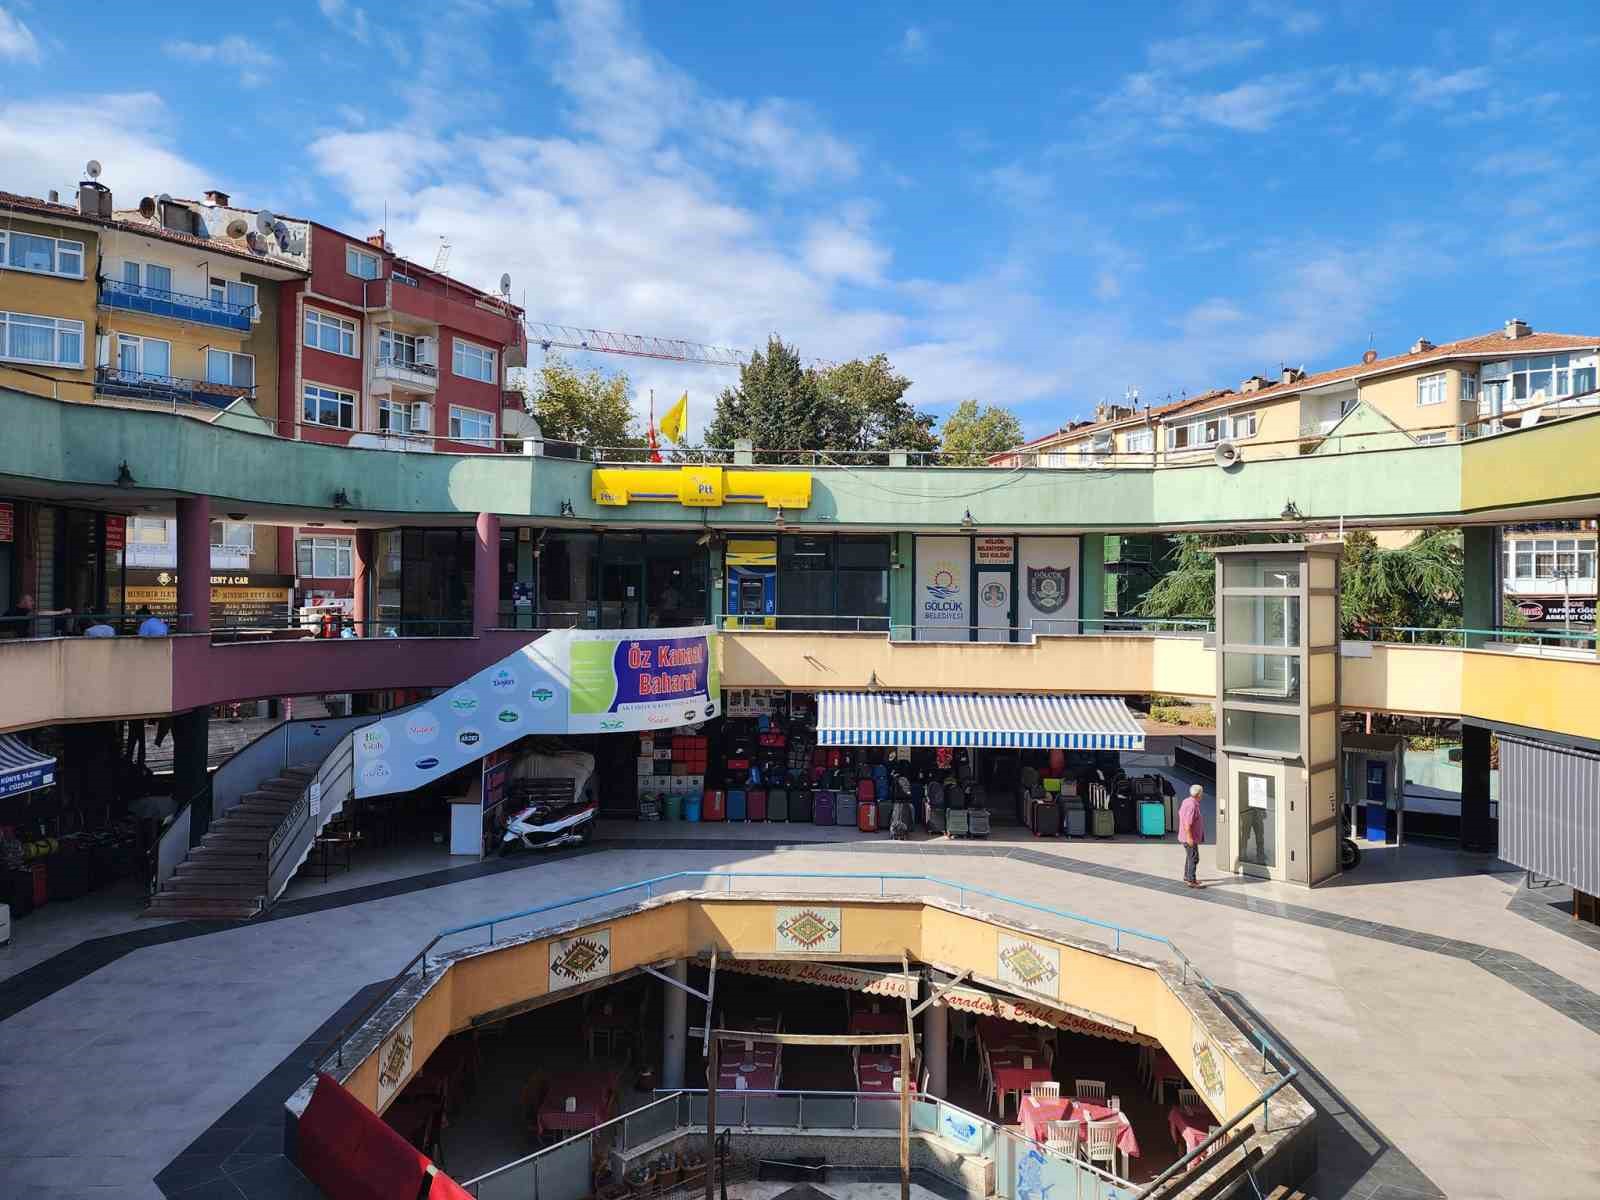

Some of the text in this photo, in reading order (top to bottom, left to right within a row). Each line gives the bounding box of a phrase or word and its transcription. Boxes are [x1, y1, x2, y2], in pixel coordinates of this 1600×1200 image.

[698, 483, 713, 495] Ptt
[228, 576, 234, 584] A
[234, 576, 249, 584] CAR
[925, 599, 962, 611] GÖLCÜK
[925, 611, 963, 621] BELEDİYESİ
[628, 642, 705, 669] Öz Kanaat
[639, 670, 697, 696] Baharat
[799, 965, 859, 986] Lokantası
[1013, 1001, 1054, 1020] Balık
